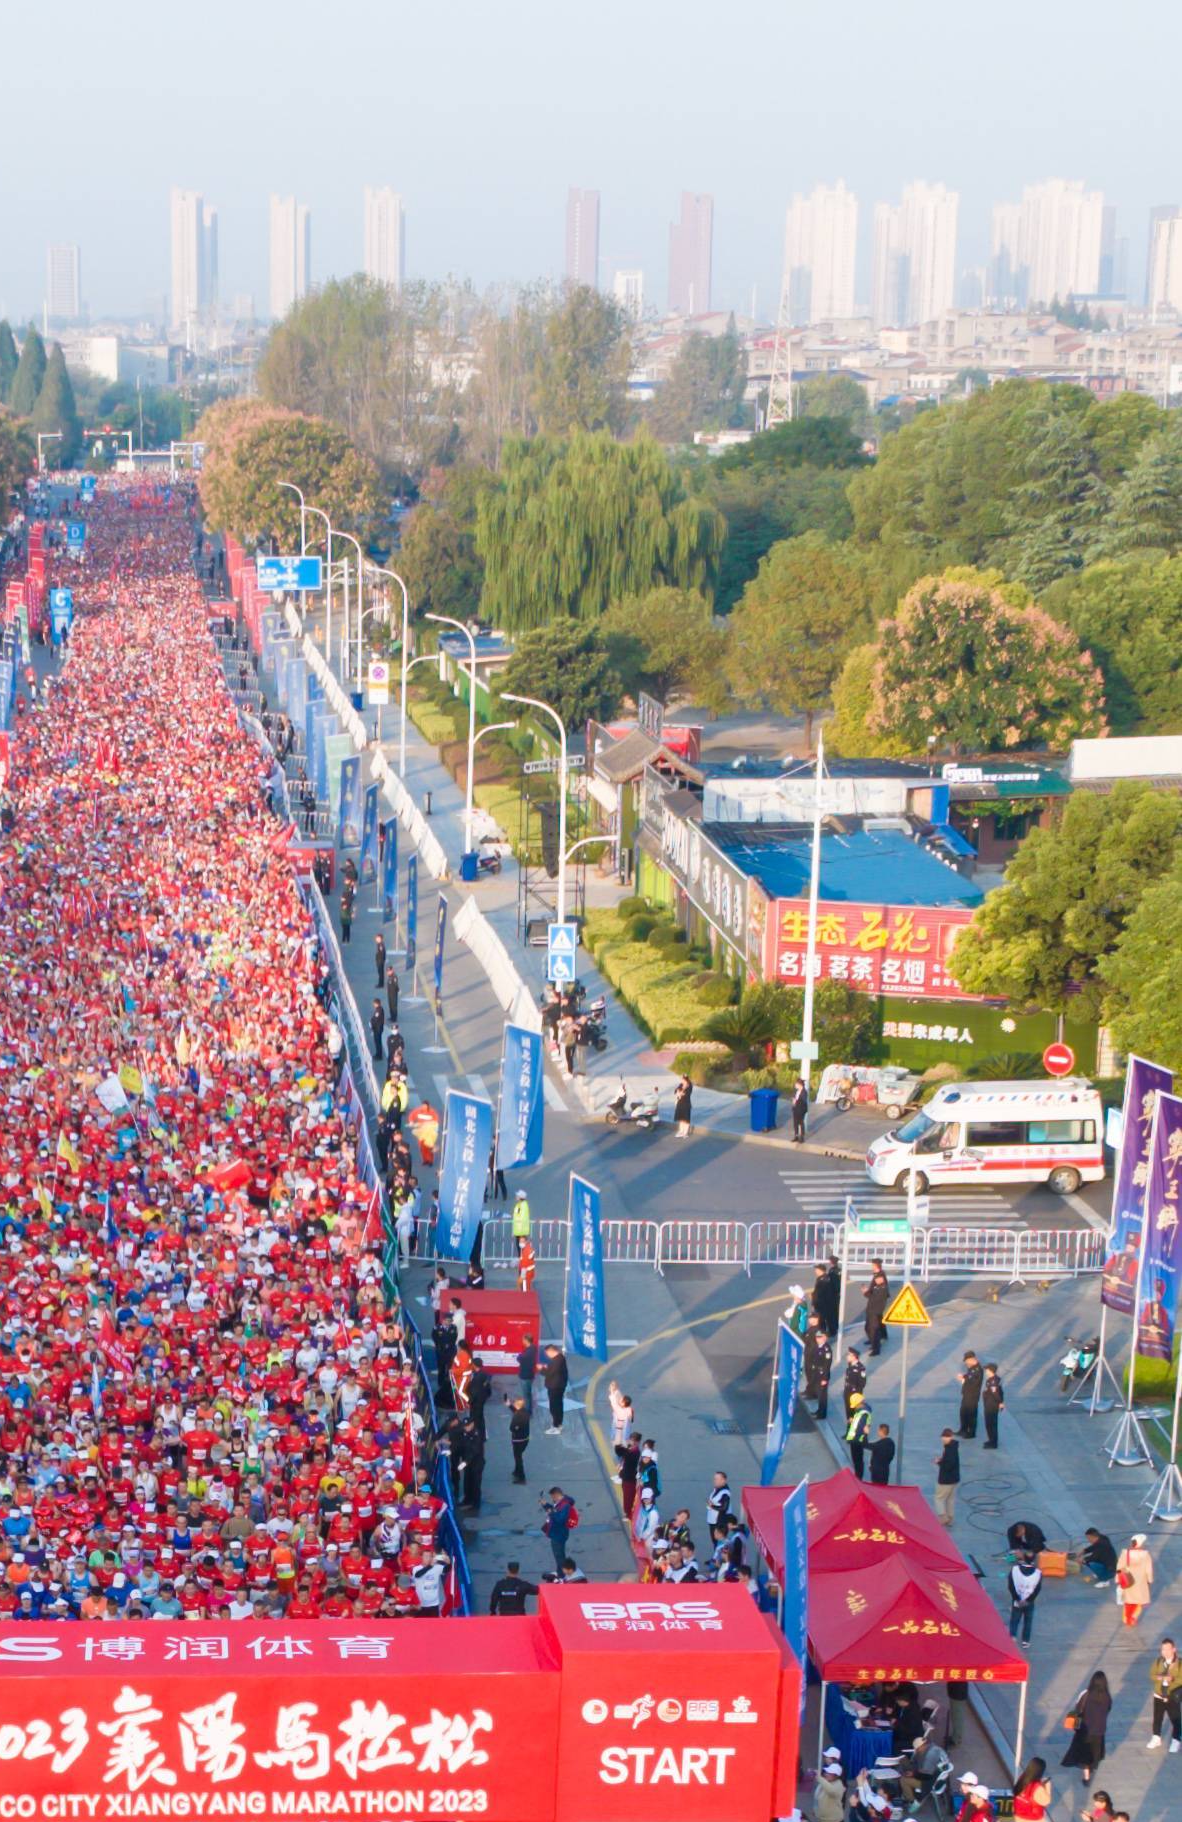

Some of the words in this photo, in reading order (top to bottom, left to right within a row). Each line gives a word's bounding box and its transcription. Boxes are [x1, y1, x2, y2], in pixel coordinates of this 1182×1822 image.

[54, 591, 67, 607] C
[580, 1601, 720, 1620] BRS
[588, 1619, 724, 1633] 博润体育
[77, 1635, 395, 1662] 博润体育
[598, 1746, 737, 1785] START
[42, 1793, 101, 1818] CITY
[105, 1791, 267, 1818] XIANGYANG
[272, 1790, 425, 1815] MARATHON
[428, 1789, 488, 1813] 2023
